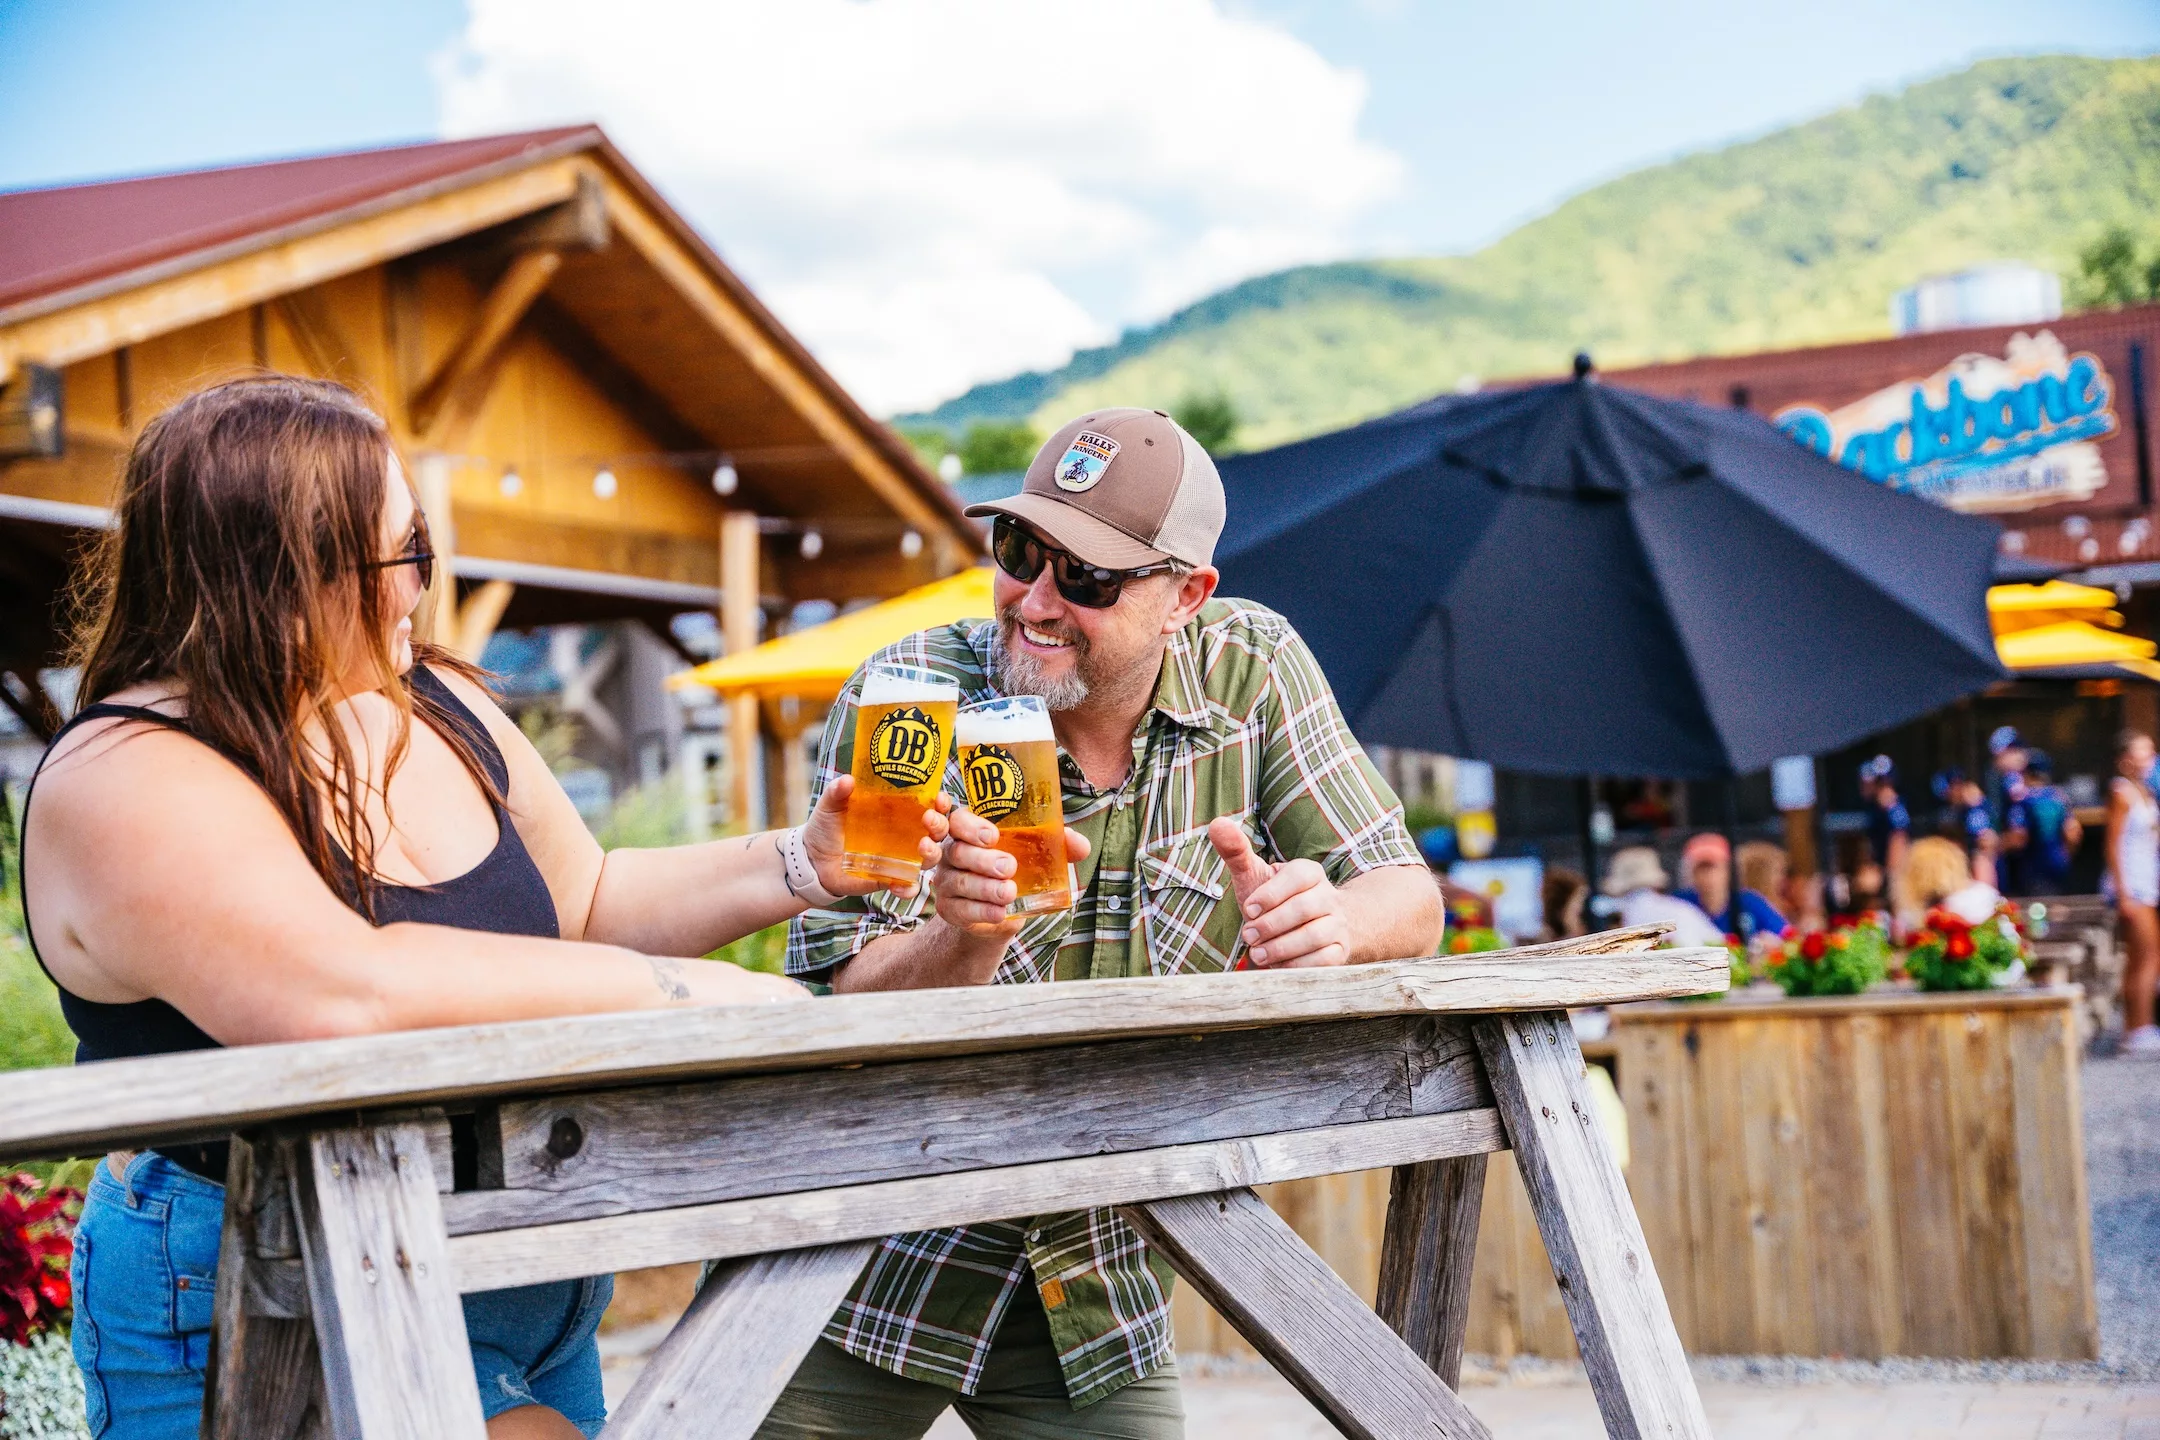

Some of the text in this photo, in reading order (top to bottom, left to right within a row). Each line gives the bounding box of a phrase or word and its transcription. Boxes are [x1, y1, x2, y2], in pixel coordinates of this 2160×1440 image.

[1079, 435, 1115, 452] RALLY
[1072, 444, 1109, 462] RANGERS
[886, 725, 929, 765] DB
[874, 764, 928, 783] DEVILS BACKBONE
[970, 762, 1007, 801] DB
[986, 800, 1018, 809] BACKBONE
